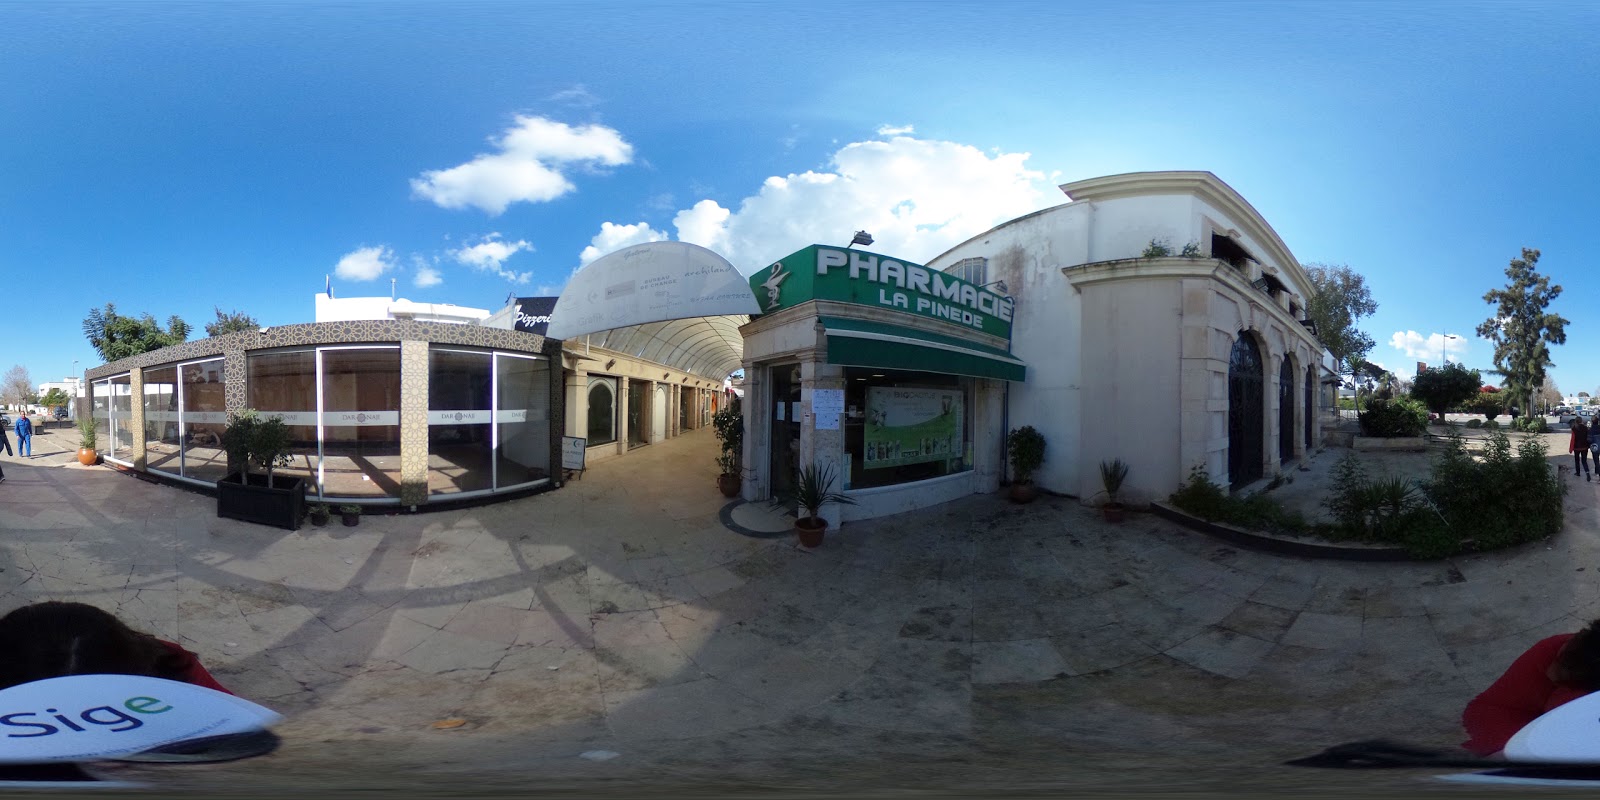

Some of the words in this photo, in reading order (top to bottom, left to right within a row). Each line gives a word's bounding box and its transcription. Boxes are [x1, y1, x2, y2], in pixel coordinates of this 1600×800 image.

[644, 275, 670, 284] BUREAU
[650, 278, 678, 288] CHANGE
[816, 248, 1014, 322] PHARMACIE
[513, 304, 553, 328] Pizzeri
[879, 288, 908, 309] LA
[917, 297, 983, 329] PINEDE
[0, 696, 173, 738] Sige
